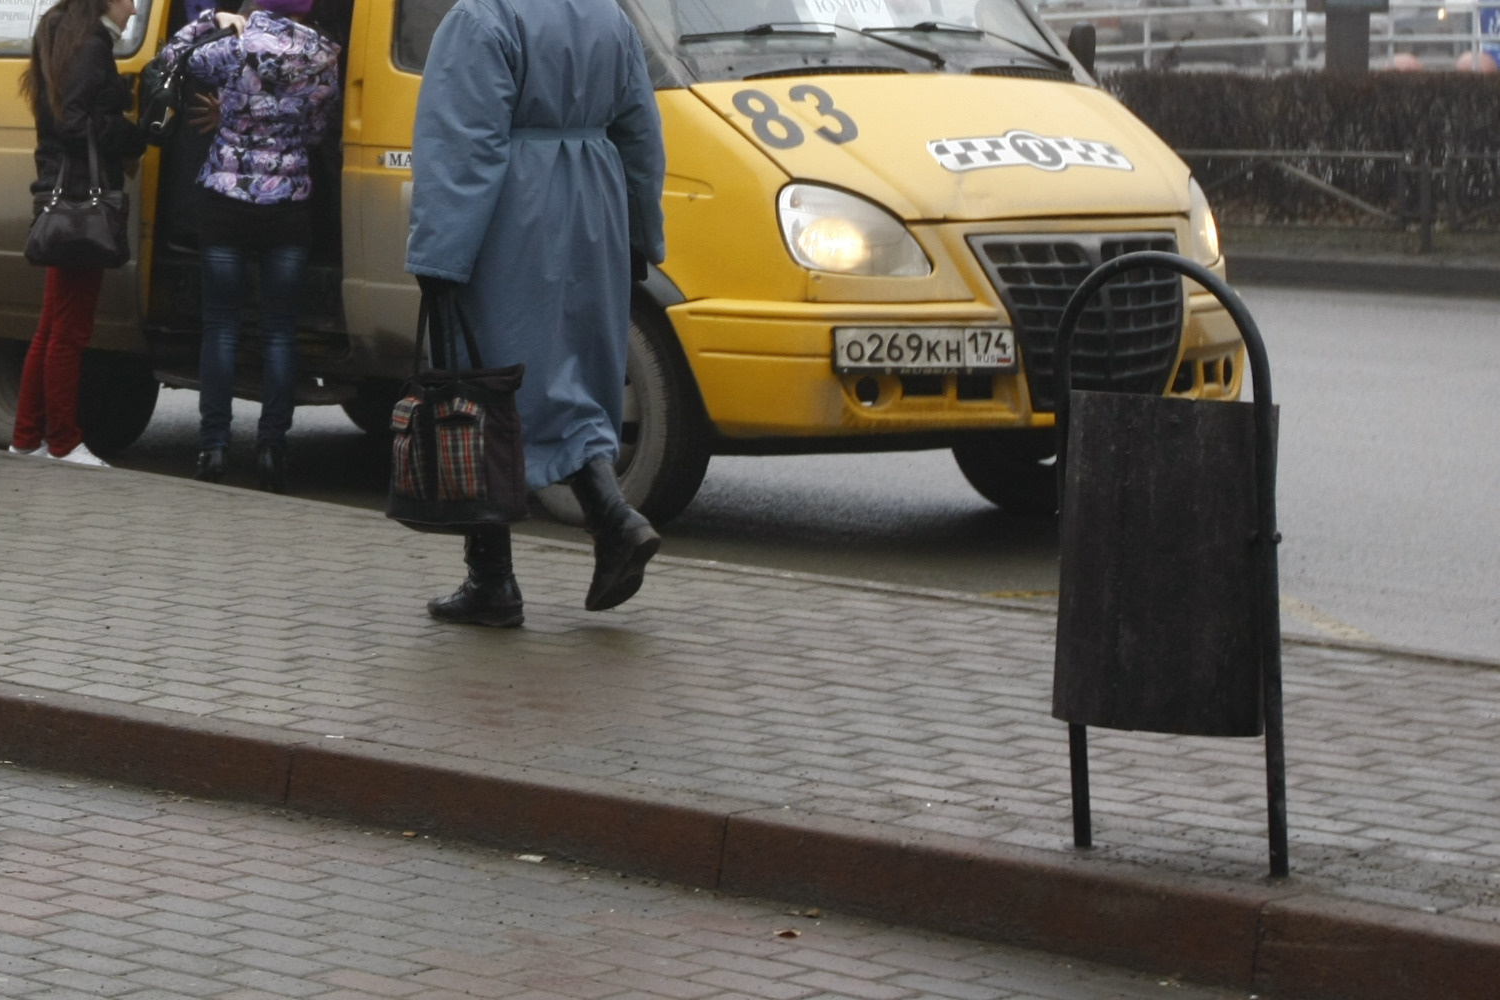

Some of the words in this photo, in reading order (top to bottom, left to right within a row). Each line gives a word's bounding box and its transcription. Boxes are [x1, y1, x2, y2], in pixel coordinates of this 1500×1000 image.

[732, 84, 859, 150] 83
[846, 333, 962, 363] О269КН
[967, 332, 1008, 355] 174
[975, 355, 997, 363] RUS
